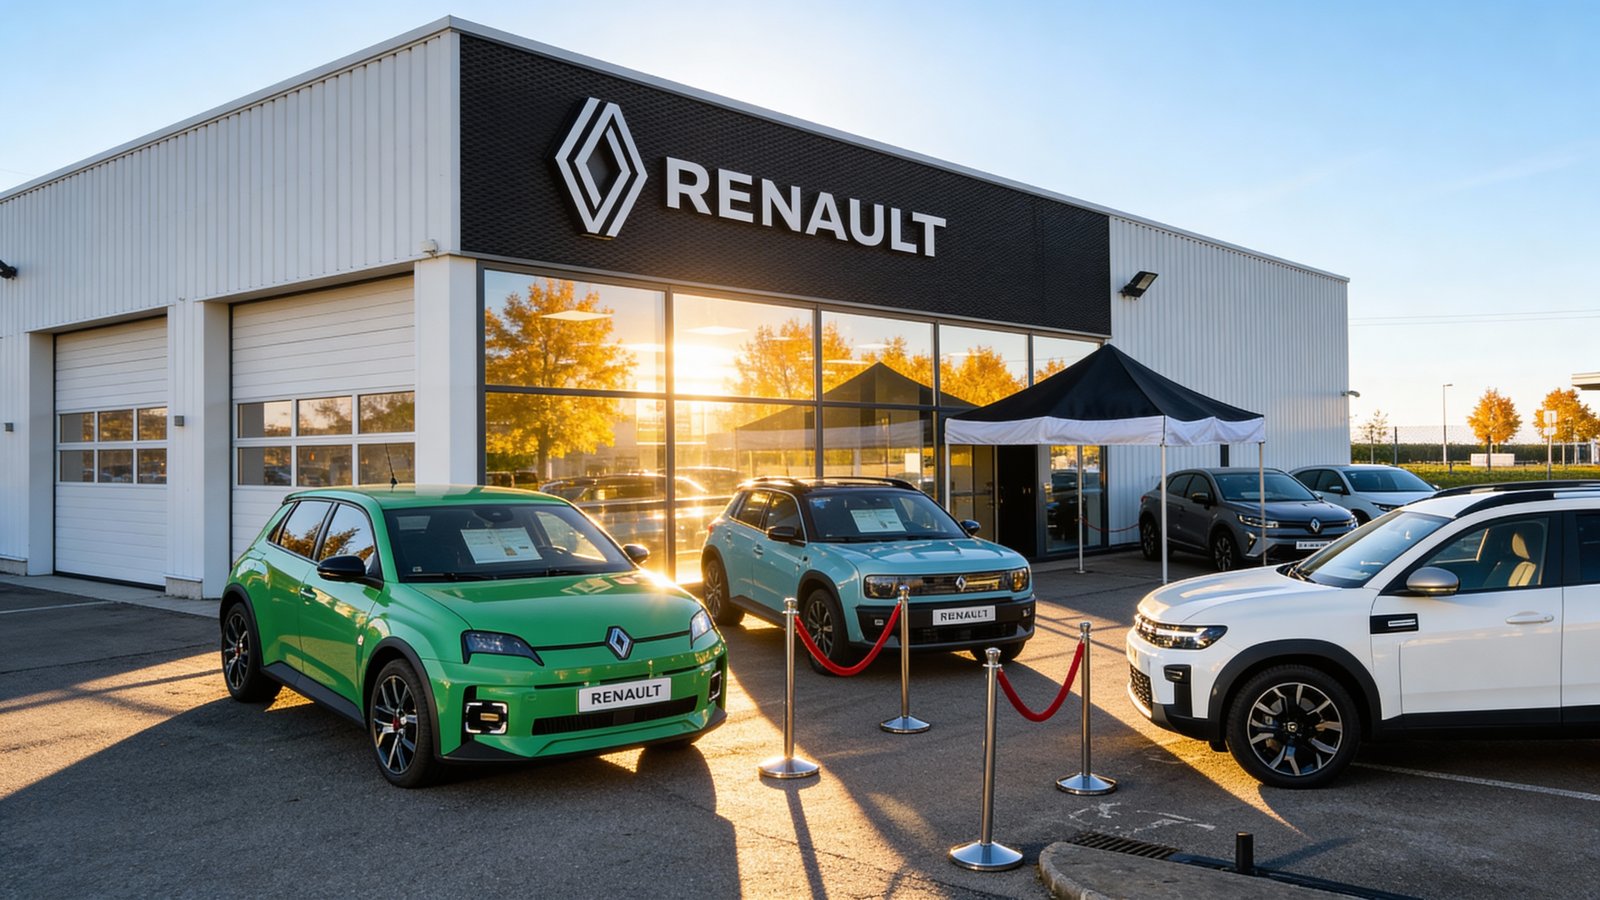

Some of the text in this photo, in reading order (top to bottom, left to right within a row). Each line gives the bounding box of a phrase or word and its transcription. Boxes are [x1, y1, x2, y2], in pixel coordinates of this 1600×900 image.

[666, 156, 947, 258] RENAULT
[940, 610, 988, 621] RENAULT
[591, 684, 662, 705] RENAULT
